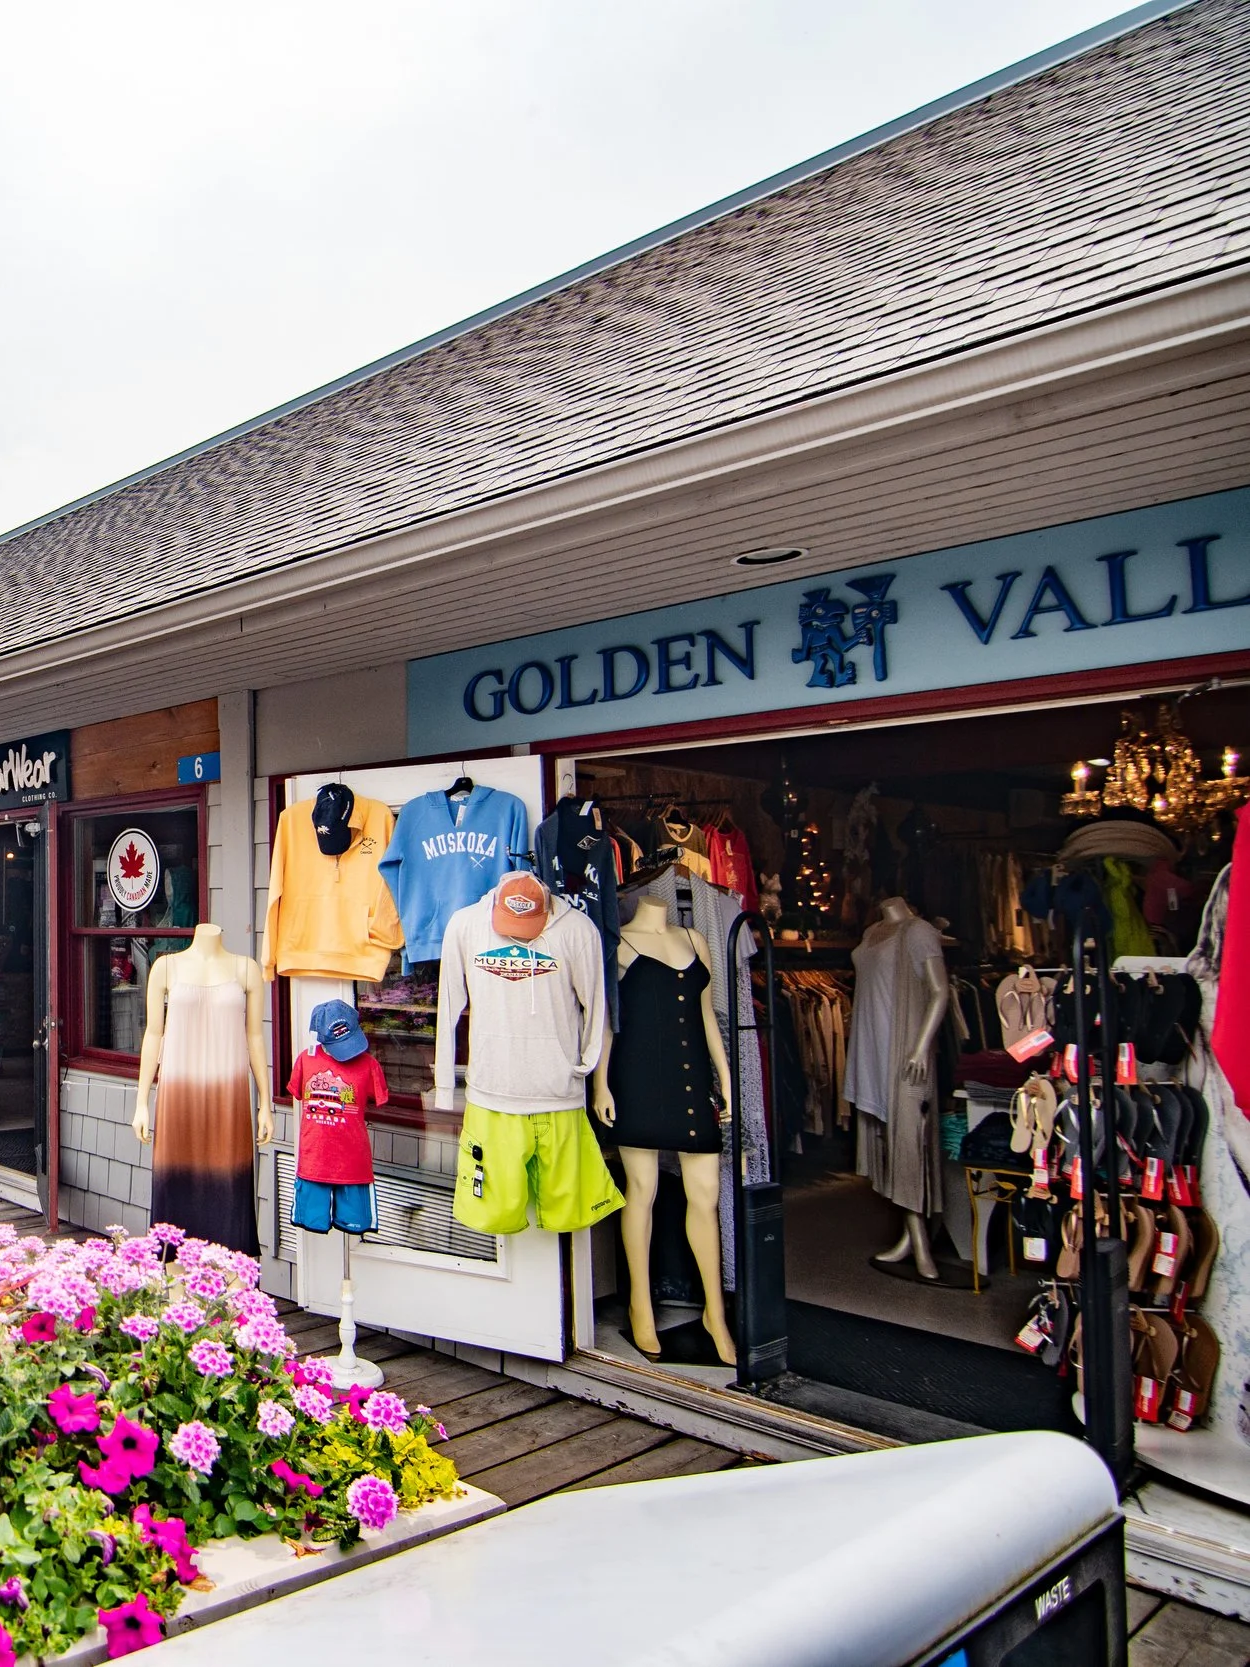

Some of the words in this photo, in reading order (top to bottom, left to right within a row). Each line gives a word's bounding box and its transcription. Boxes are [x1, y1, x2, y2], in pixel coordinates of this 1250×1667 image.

[463, 620, 760, 722] GOLDEN
[940, 534, 1250, 645] VALL
[194, 757, 204, 779] 6
[22, 793, 46, 803] CLOTHING
[48, 791, 58, 800] CO.
[422, 831, 498, 860] MUSKOKA
[114, 874, 127, 897] PROUDLY
[126, 886, 148, 901] CANADIAN
[143, 870, 153, 888] MADE
[474, 957, 558, 969] MUSKOKA
[306, 1113, 347, 1124] CANADA
[1035, 1575, 1070, 1621] WASTE
